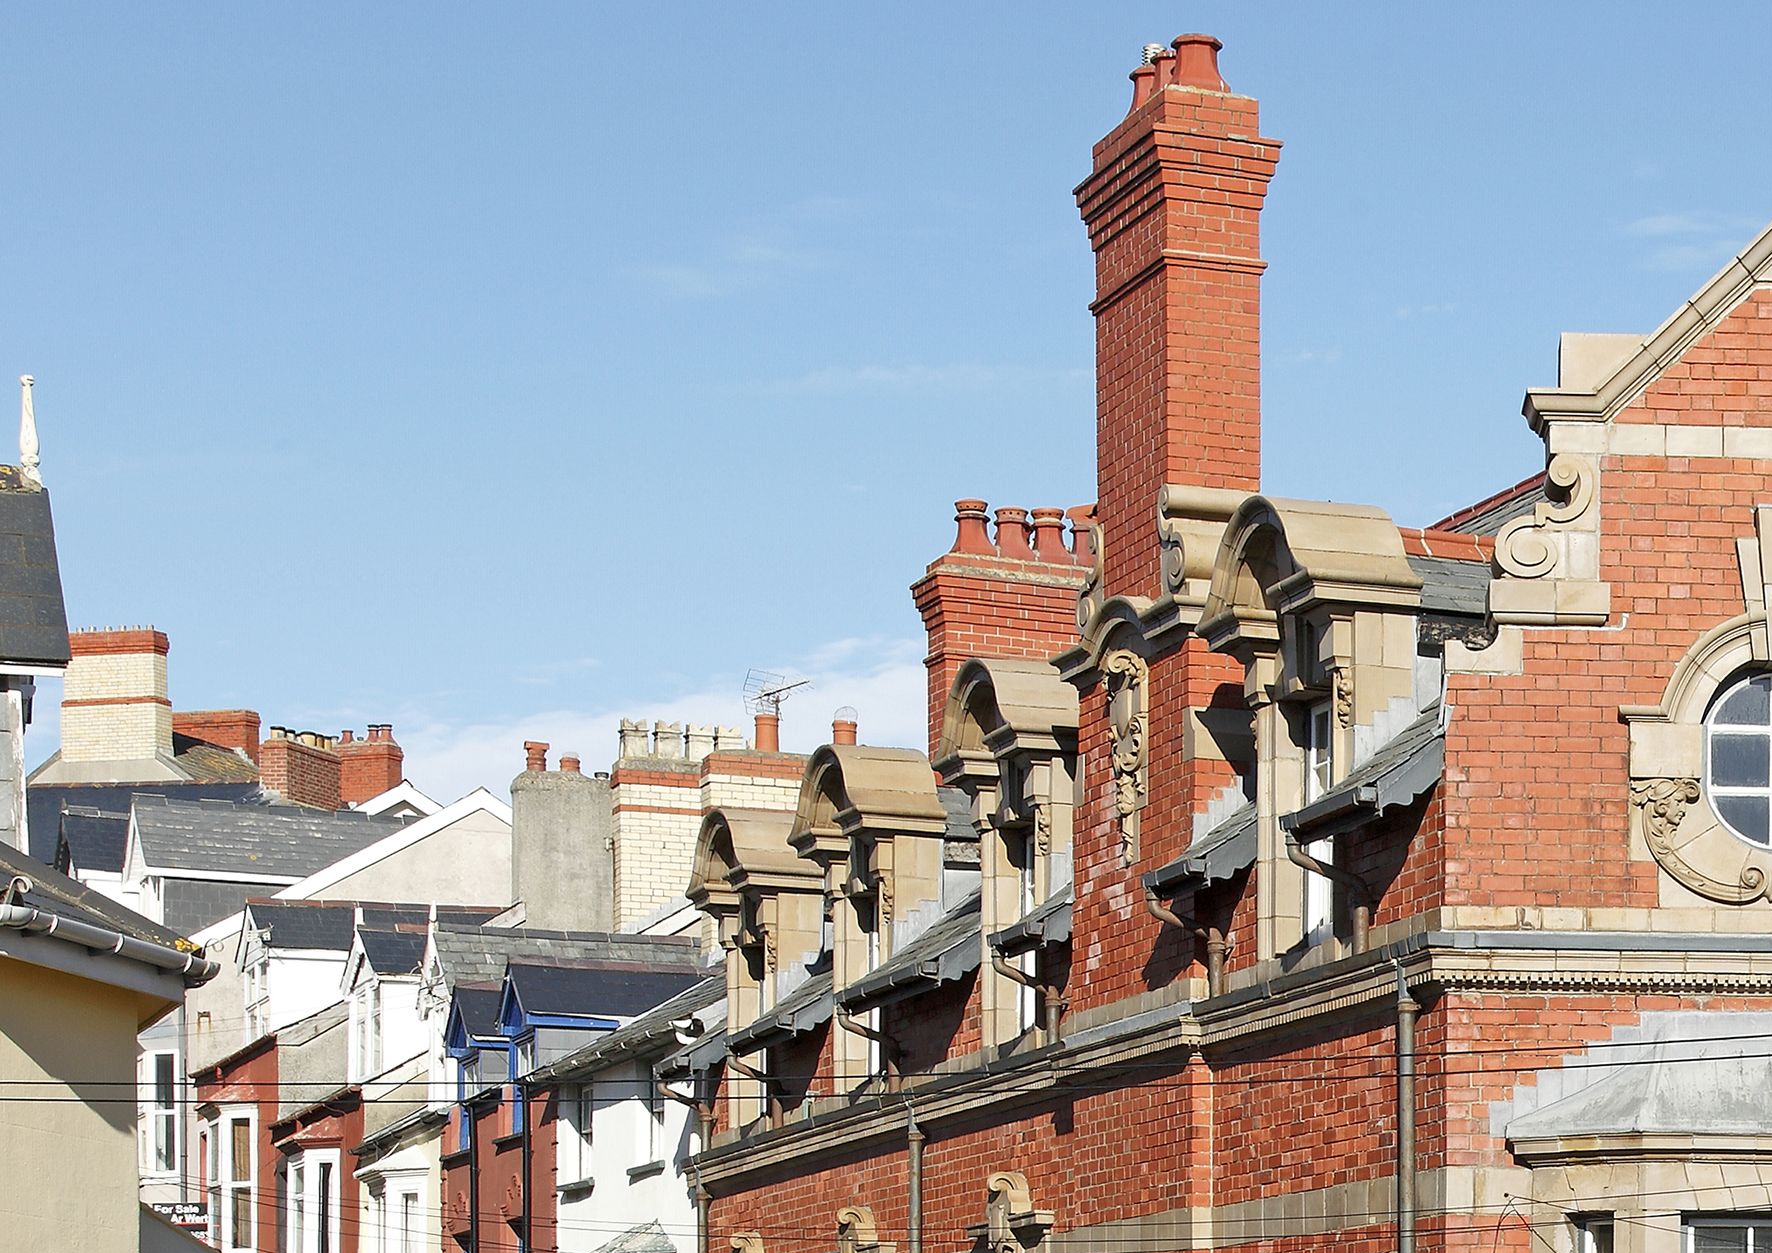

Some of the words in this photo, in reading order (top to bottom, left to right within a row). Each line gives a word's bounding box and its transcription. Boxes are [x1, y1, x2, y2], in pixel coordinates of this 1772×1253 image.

[154, 1204, 173, 1214] For
[175, 1204, 200, 1214] Sale
[184, 1213, 209, 1223] Wert
